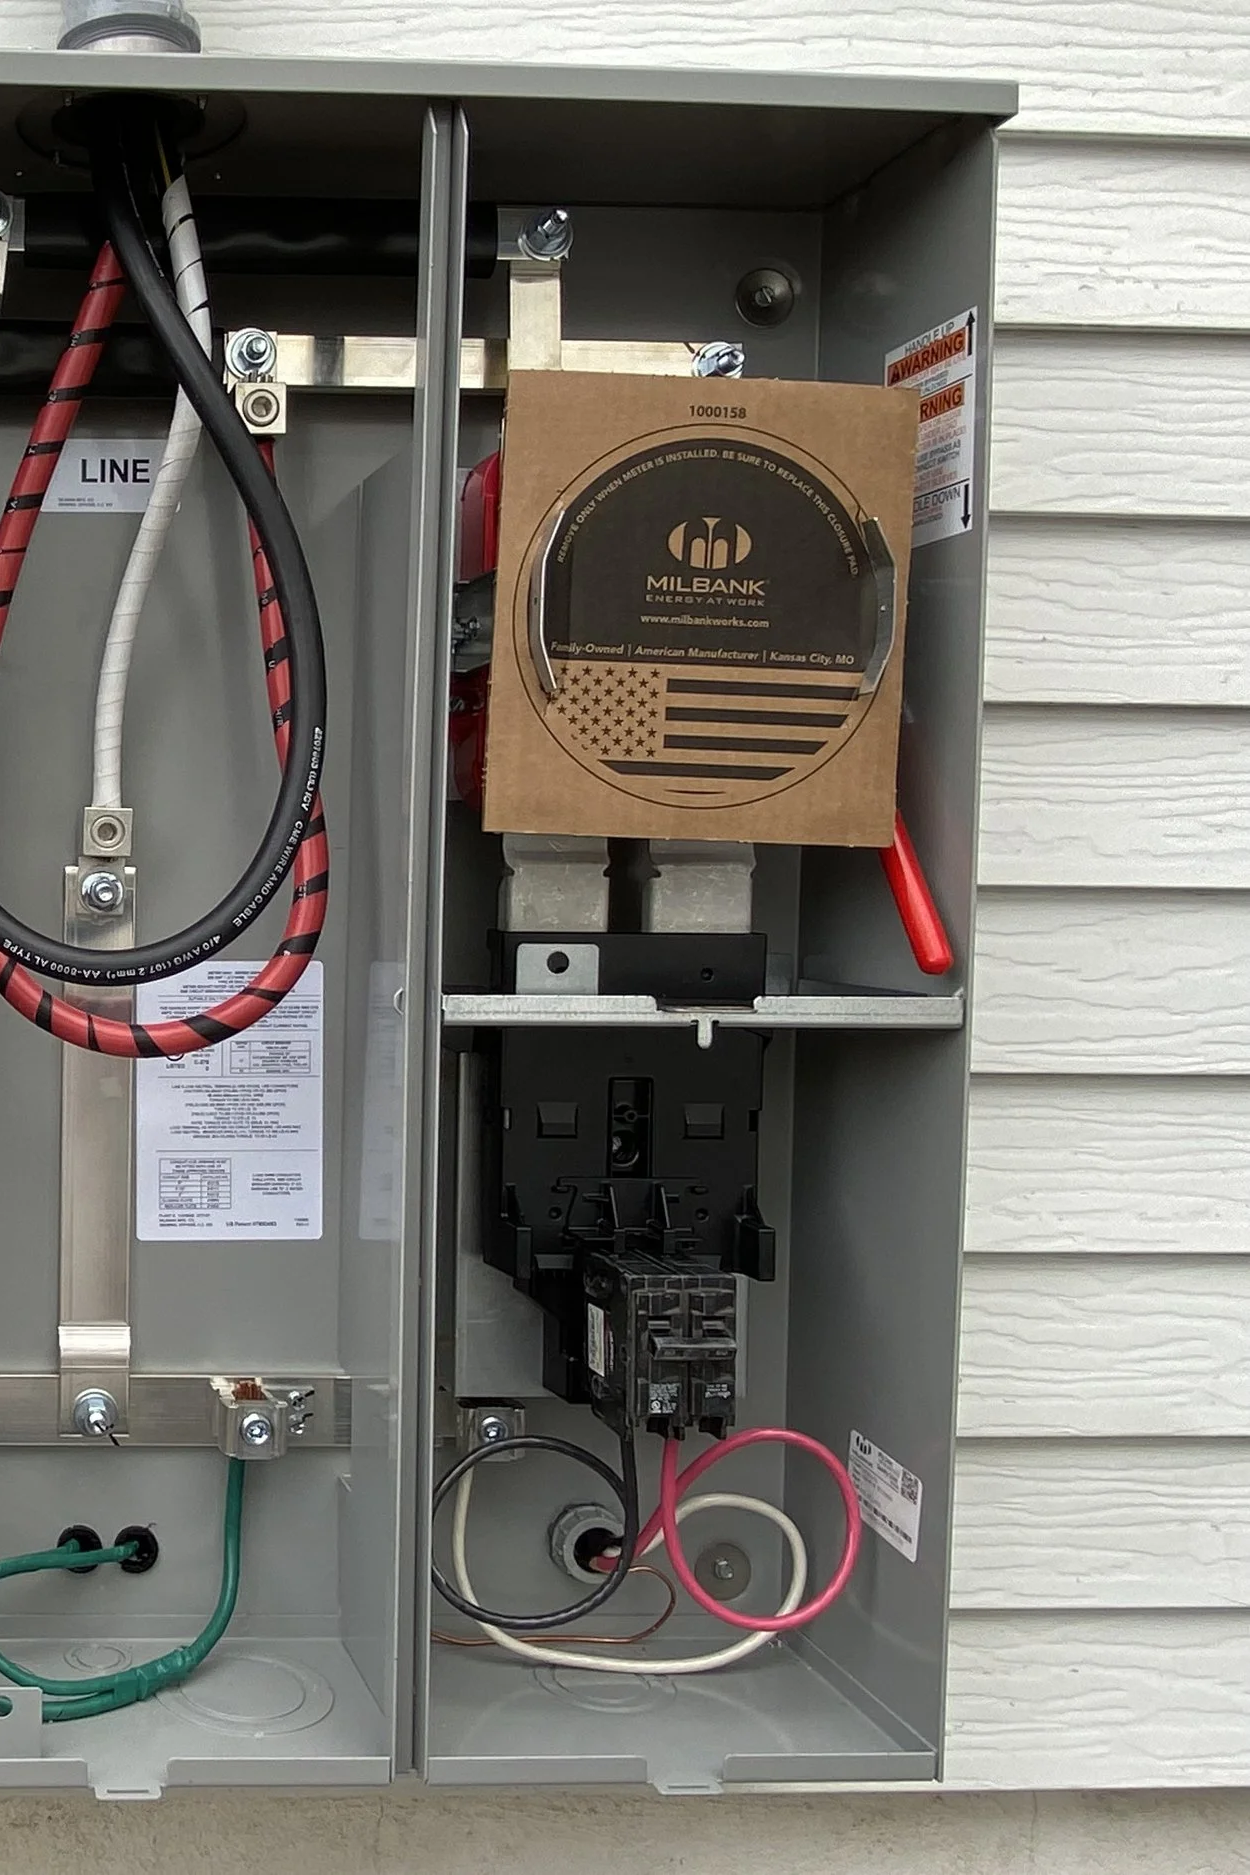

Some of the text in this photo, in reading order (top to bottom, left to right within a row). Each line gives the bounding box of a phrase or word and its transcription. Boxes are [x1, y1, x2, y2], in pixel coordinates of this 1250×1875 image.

[904, 329, 939, 354] HANDLE
[900, 334, 964, 379] WARNING
[689, 405, 747, 419] 1000158
[920, 389, 962, 422] RNING
[81, 459, 149, 483] LINE
[557, 523, 579, 564] REMOVE
[576, 500, 597, 524] ONLY
[595, 478, 623, 502] WHEN
[622, 460, 654, 482] METER
[654, 456, 664, 466] IS
[666, 449, 720, 462] INSTALLED.
[722, 450, 734, 460] BE
[738, 452, 761, 466] SURE
[763, 460, 776, 472] TO
[776, 467, 814, 498] REPLACE
[813, 494, 830, 515] THIS
[827, 513, 853, 554] CLOSURE
[914, 486, 961, 513] DLE DOWN
[647, 576, 766, 596] MILBANK
[646, 594, 703, 604] ENERGY
[726, 598, 765, 607] WORK
[640, 614, 769, 628] www.milbankworks.com
[550, 642, 854, 666] Family-Owned American Manufacturer Kansas City, MO
[301, 791, 312, 812] ICV
[288, 820, 304, 844] CME
[274, 845, 294, 874] WIRE
[261, 873, 278, 895] AND
[232, 895, 263, 927] CABLE
[3, 938, 31, 962] TYPE
[203, 934, 222, 950] 4/0
[34, 955, 49, 967] AL
[174, 948, 200, 964] AWG
[50, 961, 100, 979] AA-8000
